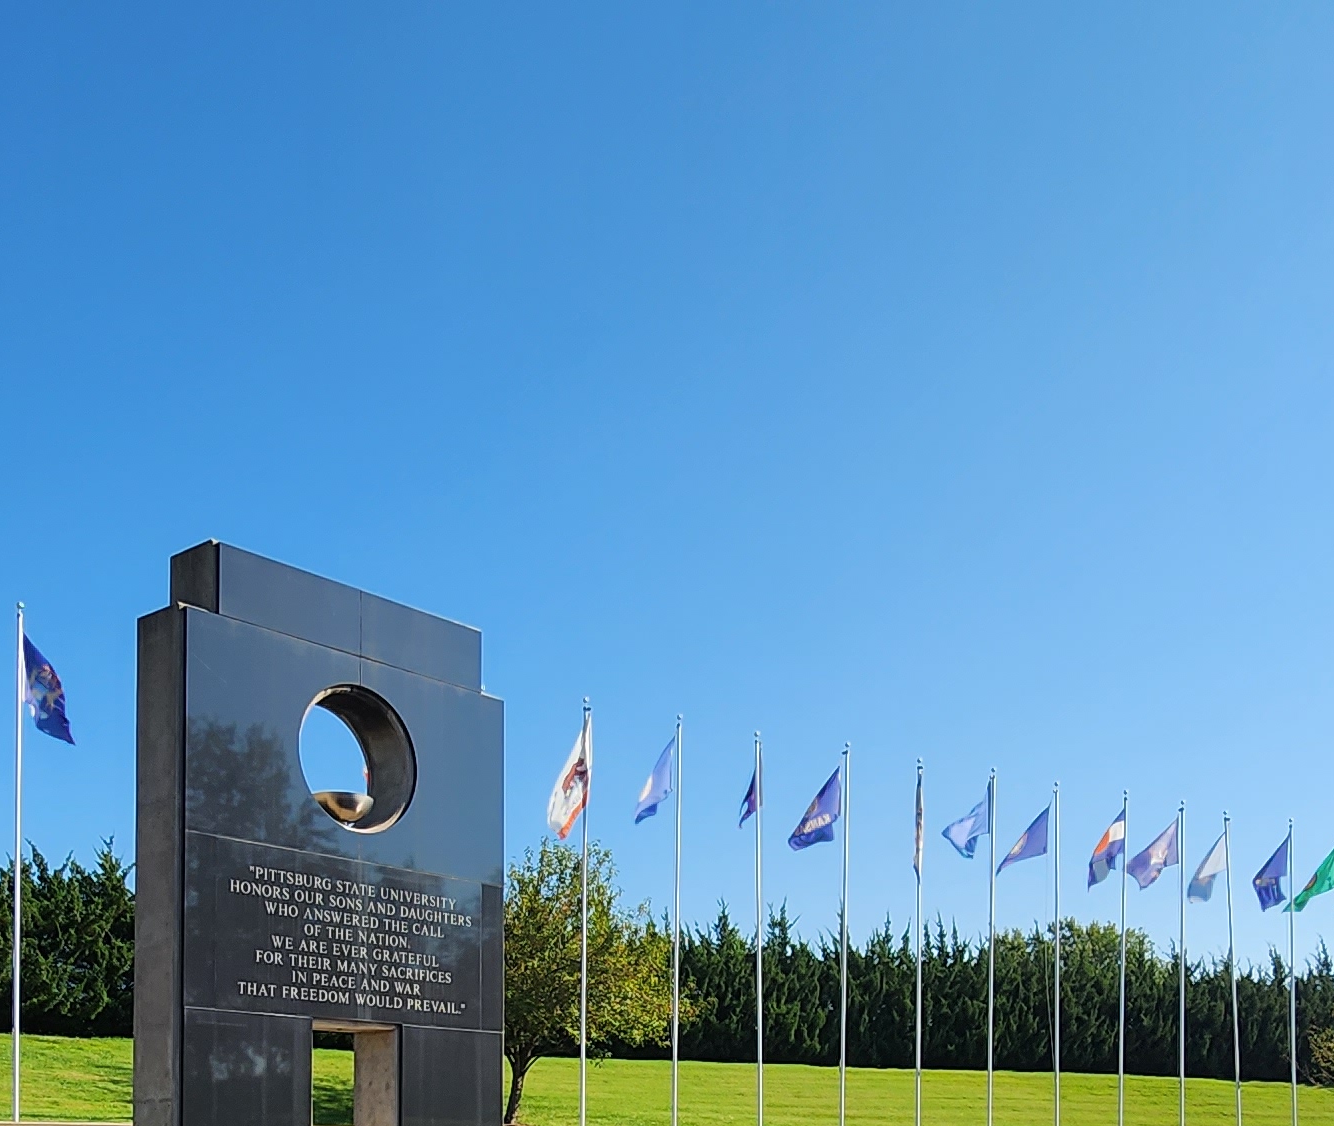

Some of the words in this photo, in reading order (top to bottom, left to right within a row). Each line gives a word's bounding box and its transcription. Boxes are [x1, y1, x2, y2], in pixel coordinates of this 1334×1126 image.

[230, 879, 289, 900] HONORS
[295, 890, 324, 906] OUR
[329, 895, 362, 911] SONS
[367, 901, 395, 916] AND
[401, 906, 471, 927] DAUGHTERS
[337, 880, 375, 897] STATE
[381, 887, 457, 910] UNIVERSITY
[265, 901, 299, 917] WHO
[303, 908, 379, 928] ANSWERED
[383, 919, 408, 933] THE
[413, 923, 445, 938] CALL
[272, 934, 293, 950] WE
[299, 940, 327, 954] ARE
[333, 943, 368, 959] EVER
[373, 948, 439, 968] GRATEFUL
[304, 924, 321, 936] OF
[326, 926, 353, 941] THE
[358, 930, 411, 949] NATION.
[255, 950, 283, 965] FOR
[289, 954, 331, 970] THEIR
[337, 960, 377, 976] MANY
[382, 966, 451, 984] SACRIFICES
[292, 970, 307, 984] IN
[313, 973, 356, 989] PEACE
[361, 978, 389, 992] AND
[394, 982, 421, 996] WAR
[237, 982, 277, 998] THAT
[282, 986, 349, 1004] FREEDOM
[355, 993, 403, 1009] WOULD
